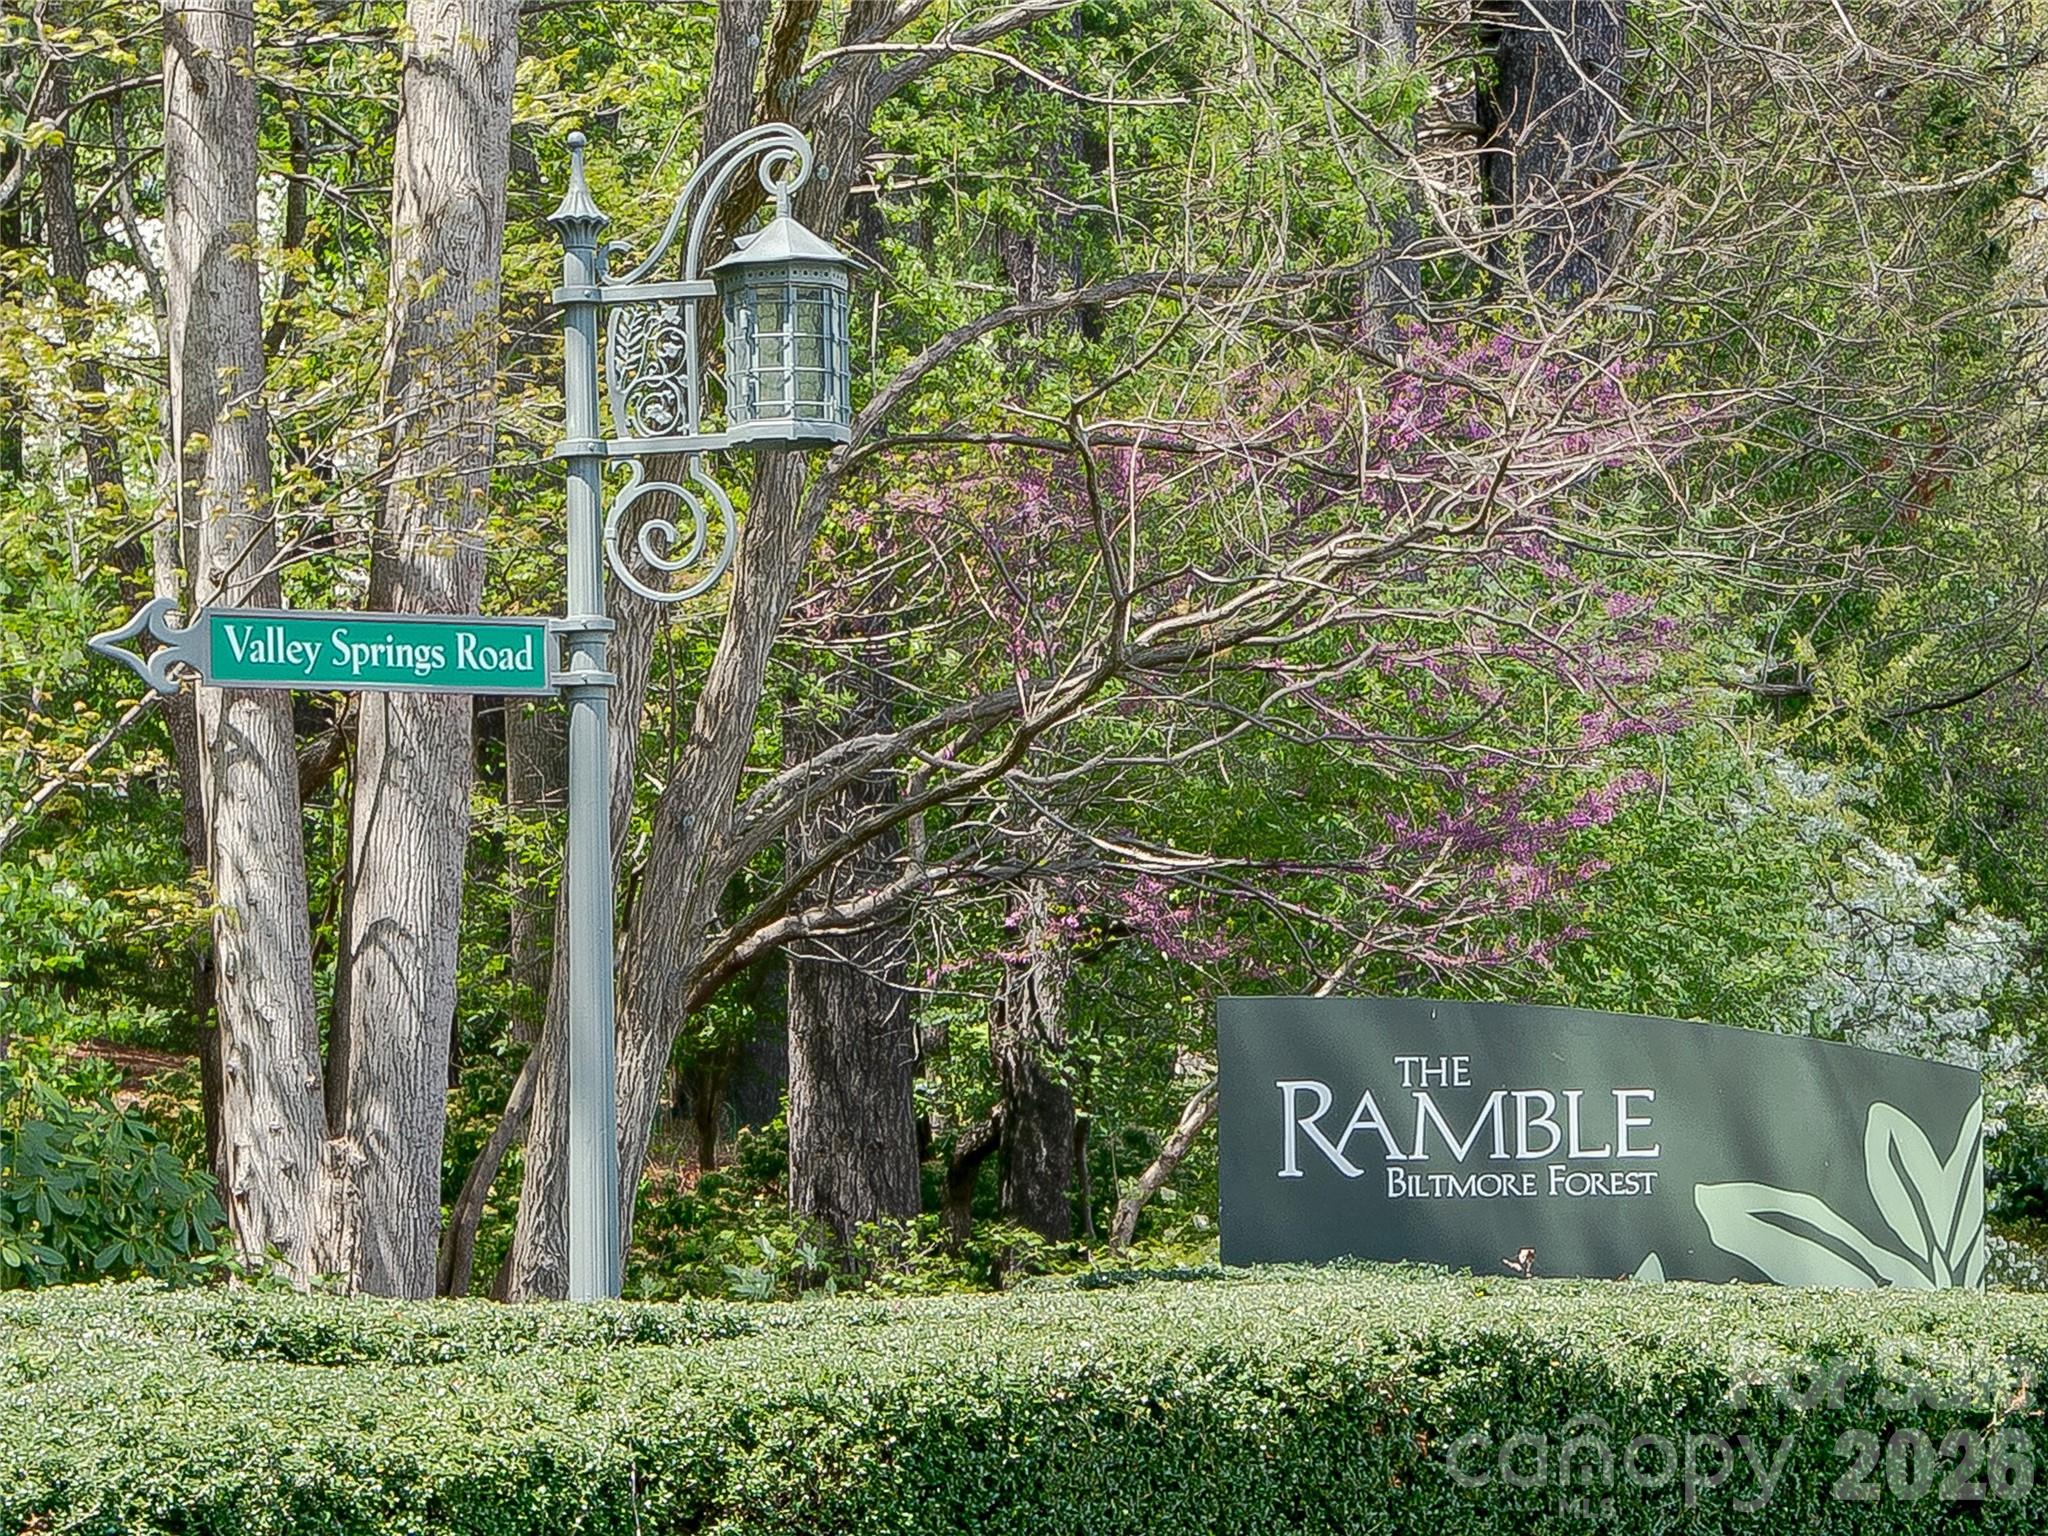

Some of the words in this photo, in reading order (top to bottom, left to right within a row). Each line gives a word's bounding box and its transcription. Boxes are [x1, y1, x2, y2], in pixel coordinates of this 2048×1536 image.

[223, 624, 322, 675] Valley
[331, 627, 446, 677] Springs
[455, 631, 535, 672] Road
[1393, 1055, 1472, 1088] THE
[1275, 1079, 1661, 1178] RAMBLE
[1386, 1166, 1538, 1199] BILTMORE
[1548, 1164, 1658, 1197] FOREST
